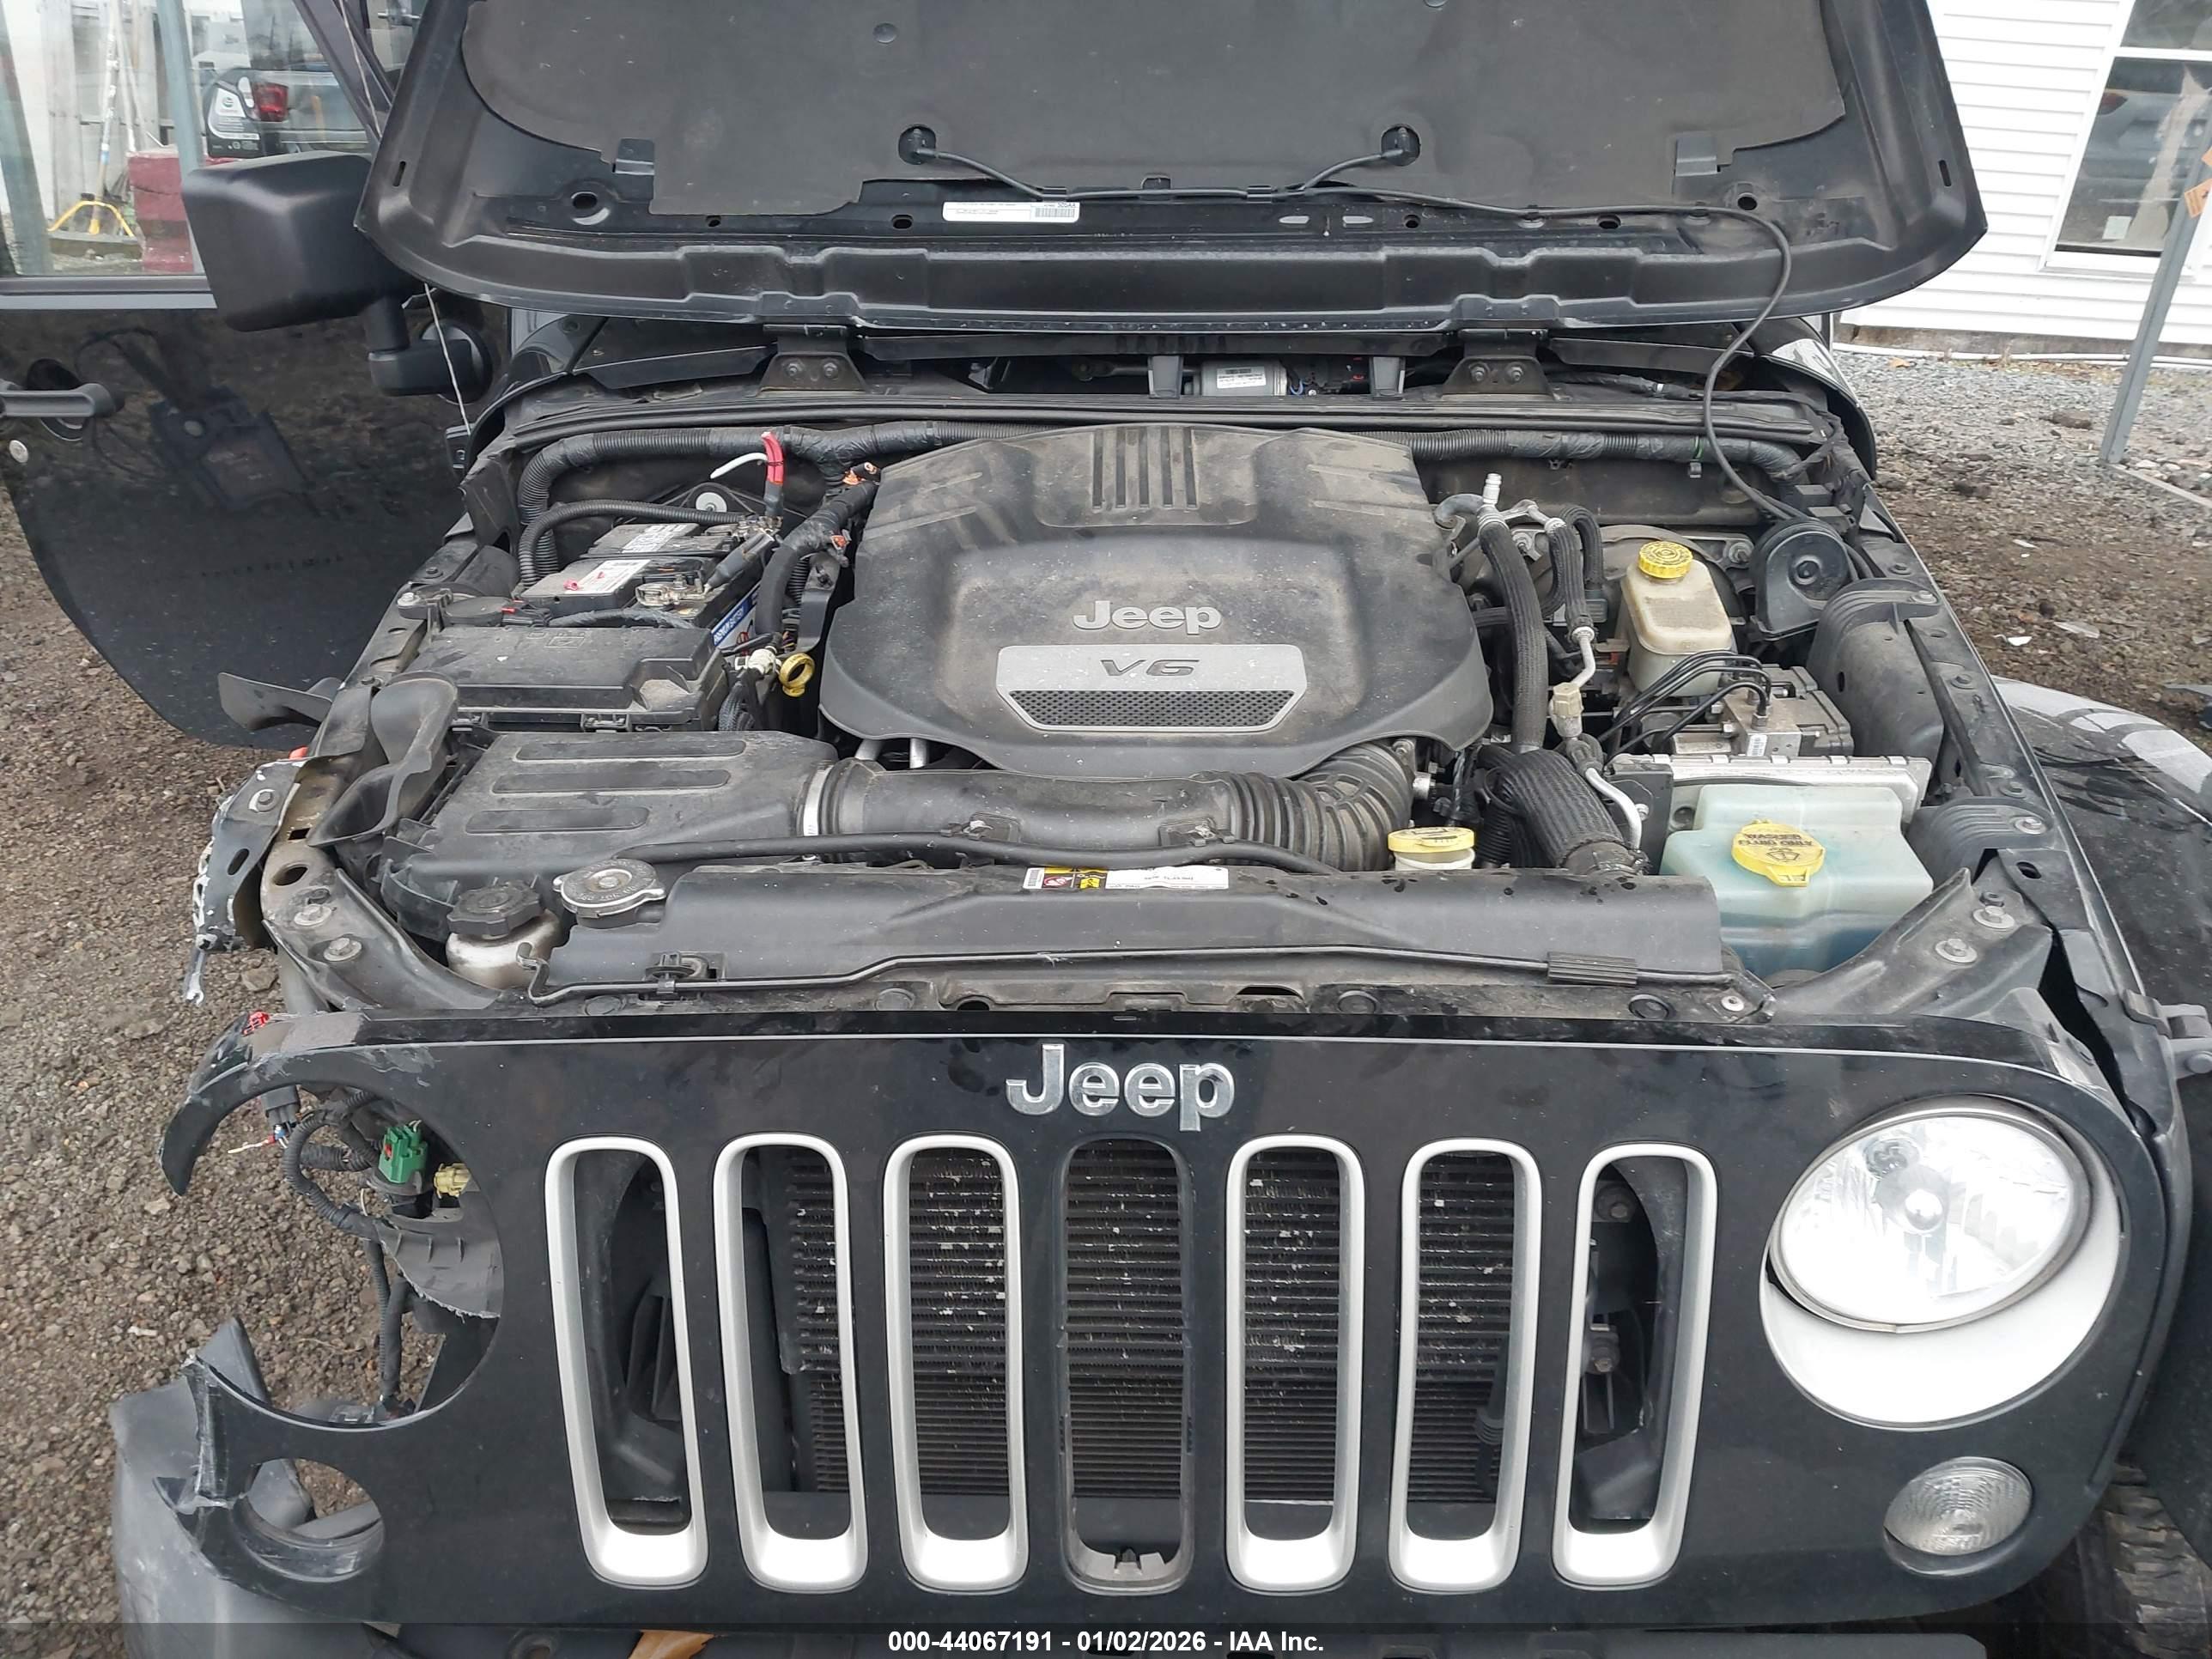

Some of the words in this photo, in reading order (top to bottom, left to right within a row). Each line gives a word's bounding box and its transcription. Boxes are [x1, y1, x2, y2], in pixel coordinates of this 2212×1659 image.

[1073, 600, 1221, 635] Jeep
[1100, 659, 1200, 677] V6
[1006, 1043, 1235, 1133] Jeep
